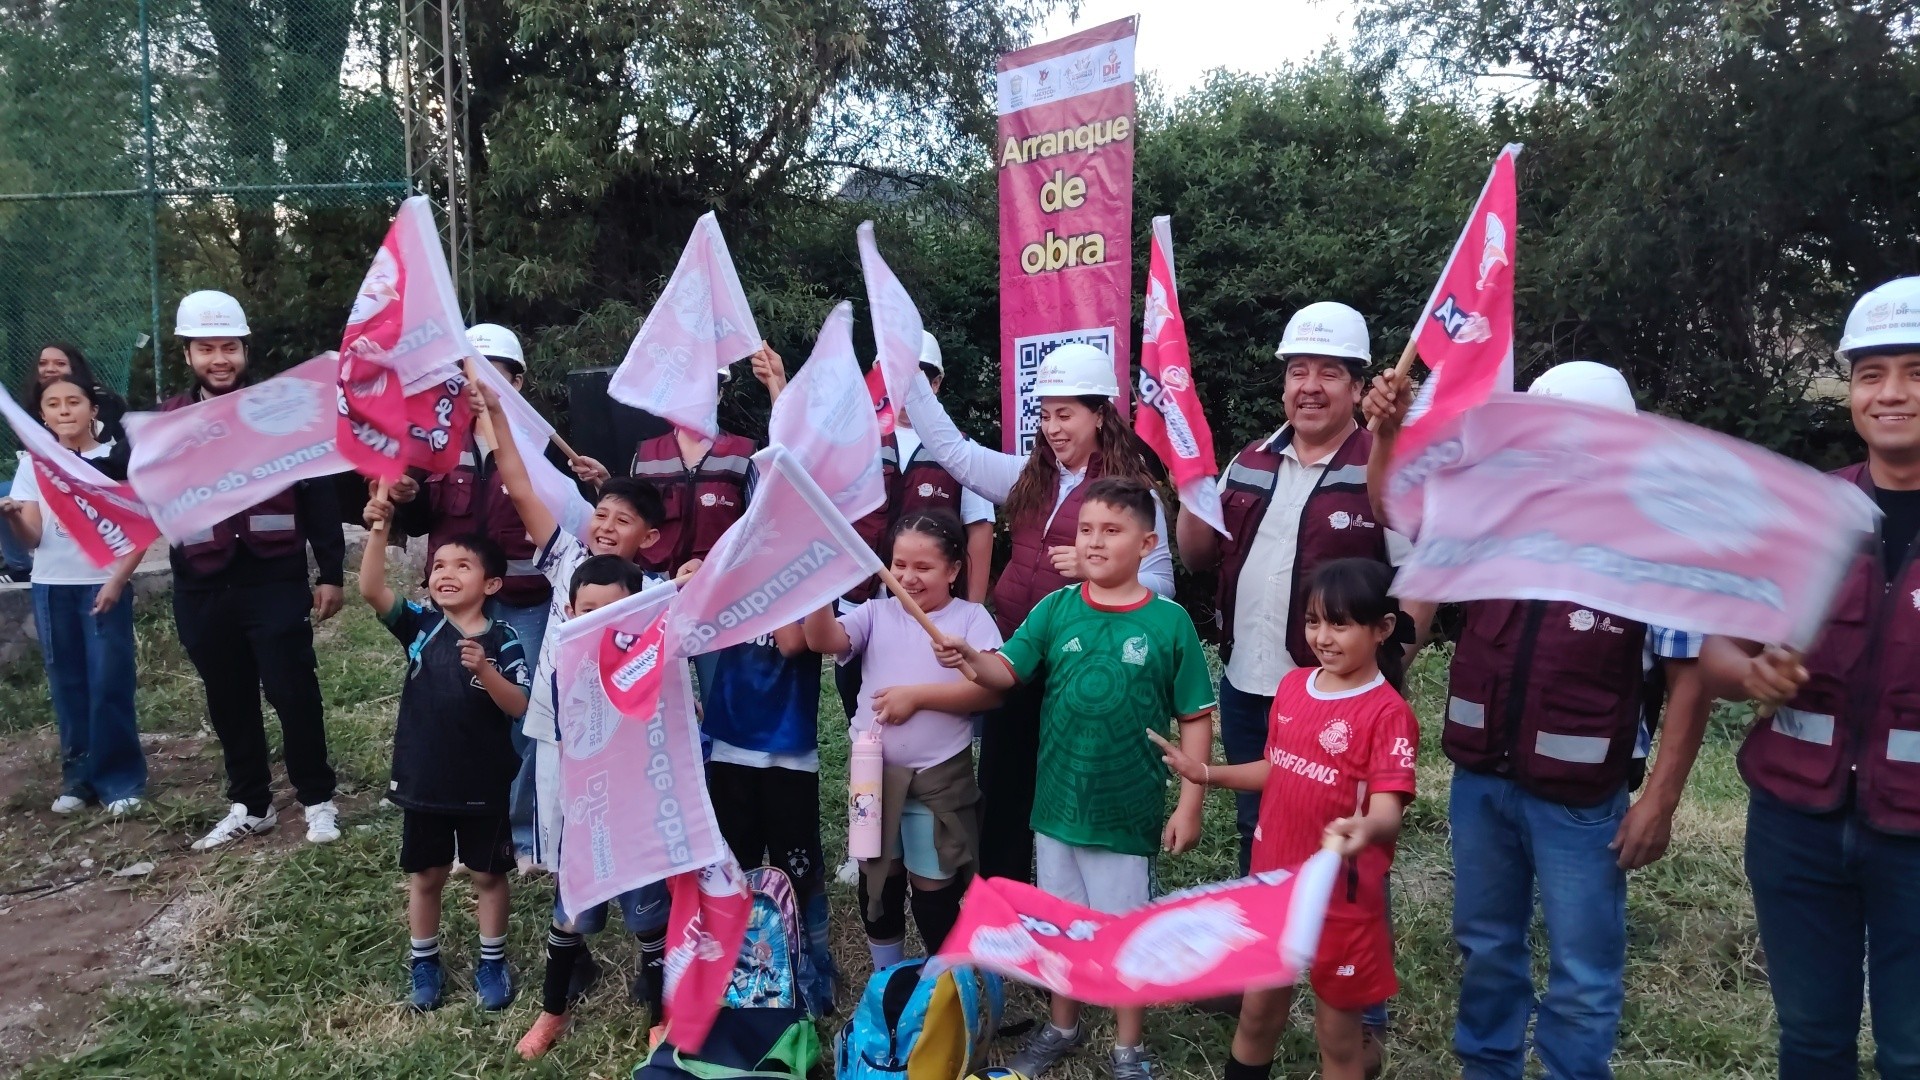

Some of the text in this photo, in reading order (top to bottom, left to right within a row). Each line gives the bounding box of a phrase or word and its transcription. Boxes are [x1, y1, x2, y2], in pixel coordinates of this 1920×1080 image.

[1103, 62, 1121, 76] DIF
[1001, 116, 1130, 168] Arranque
[1040, 170, 1086, 213] de
[1021, 231, 1105, 274] obra
